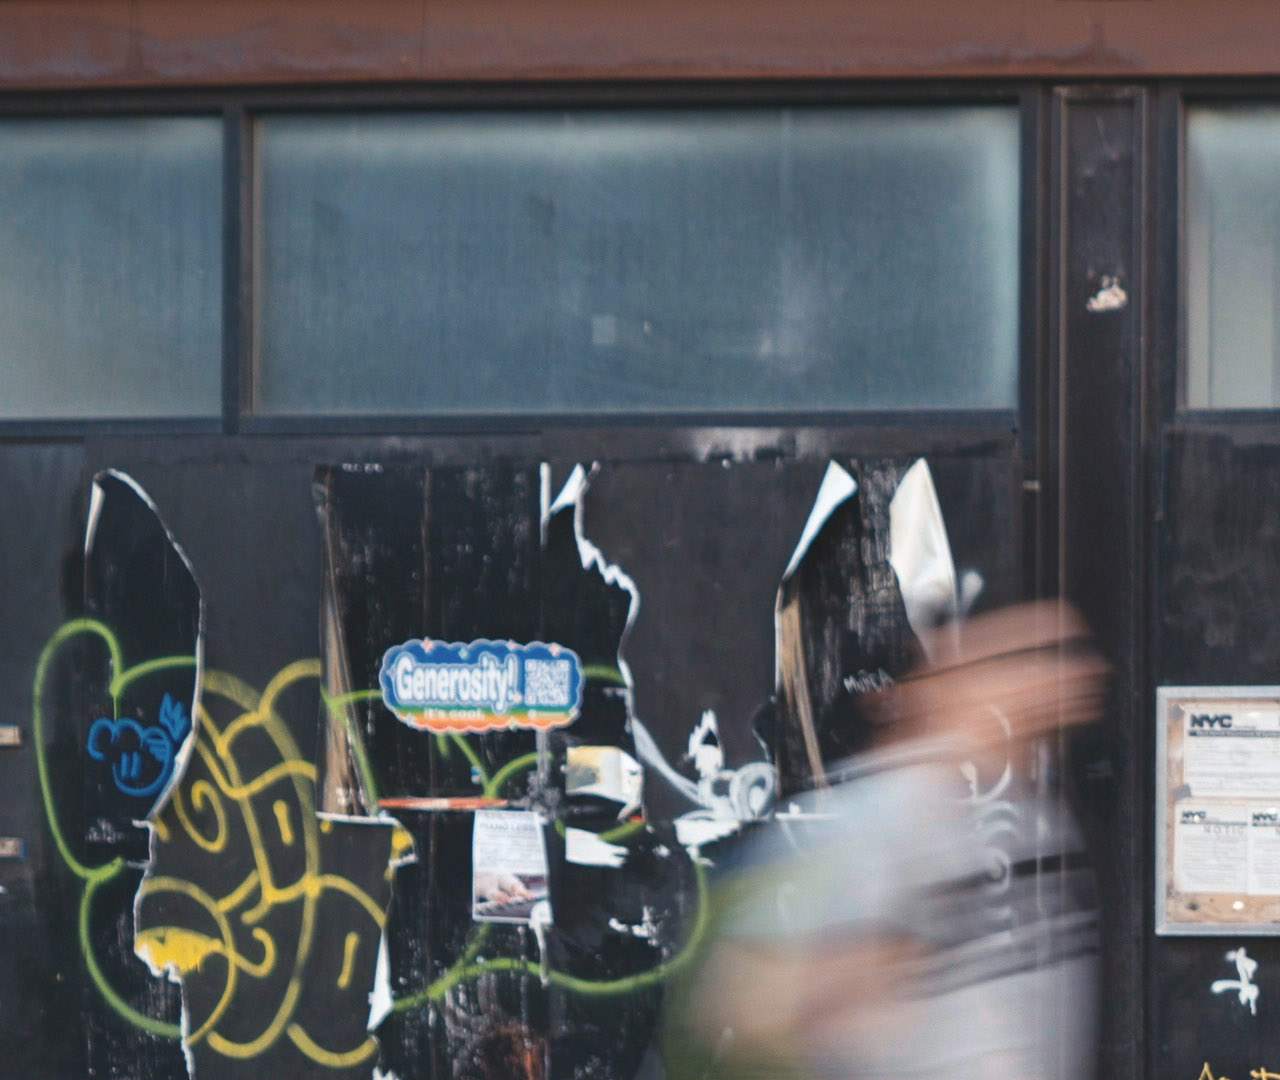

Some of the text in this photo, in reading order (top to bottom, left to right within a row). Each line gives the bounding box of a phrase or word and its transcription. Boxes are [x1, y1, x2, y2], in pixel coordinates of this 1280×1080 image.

[395, 654, 518, 711] Generosity!
[1189, 713, 1233, 729] NYC
[1252, 813, 1278, 822] NYC
